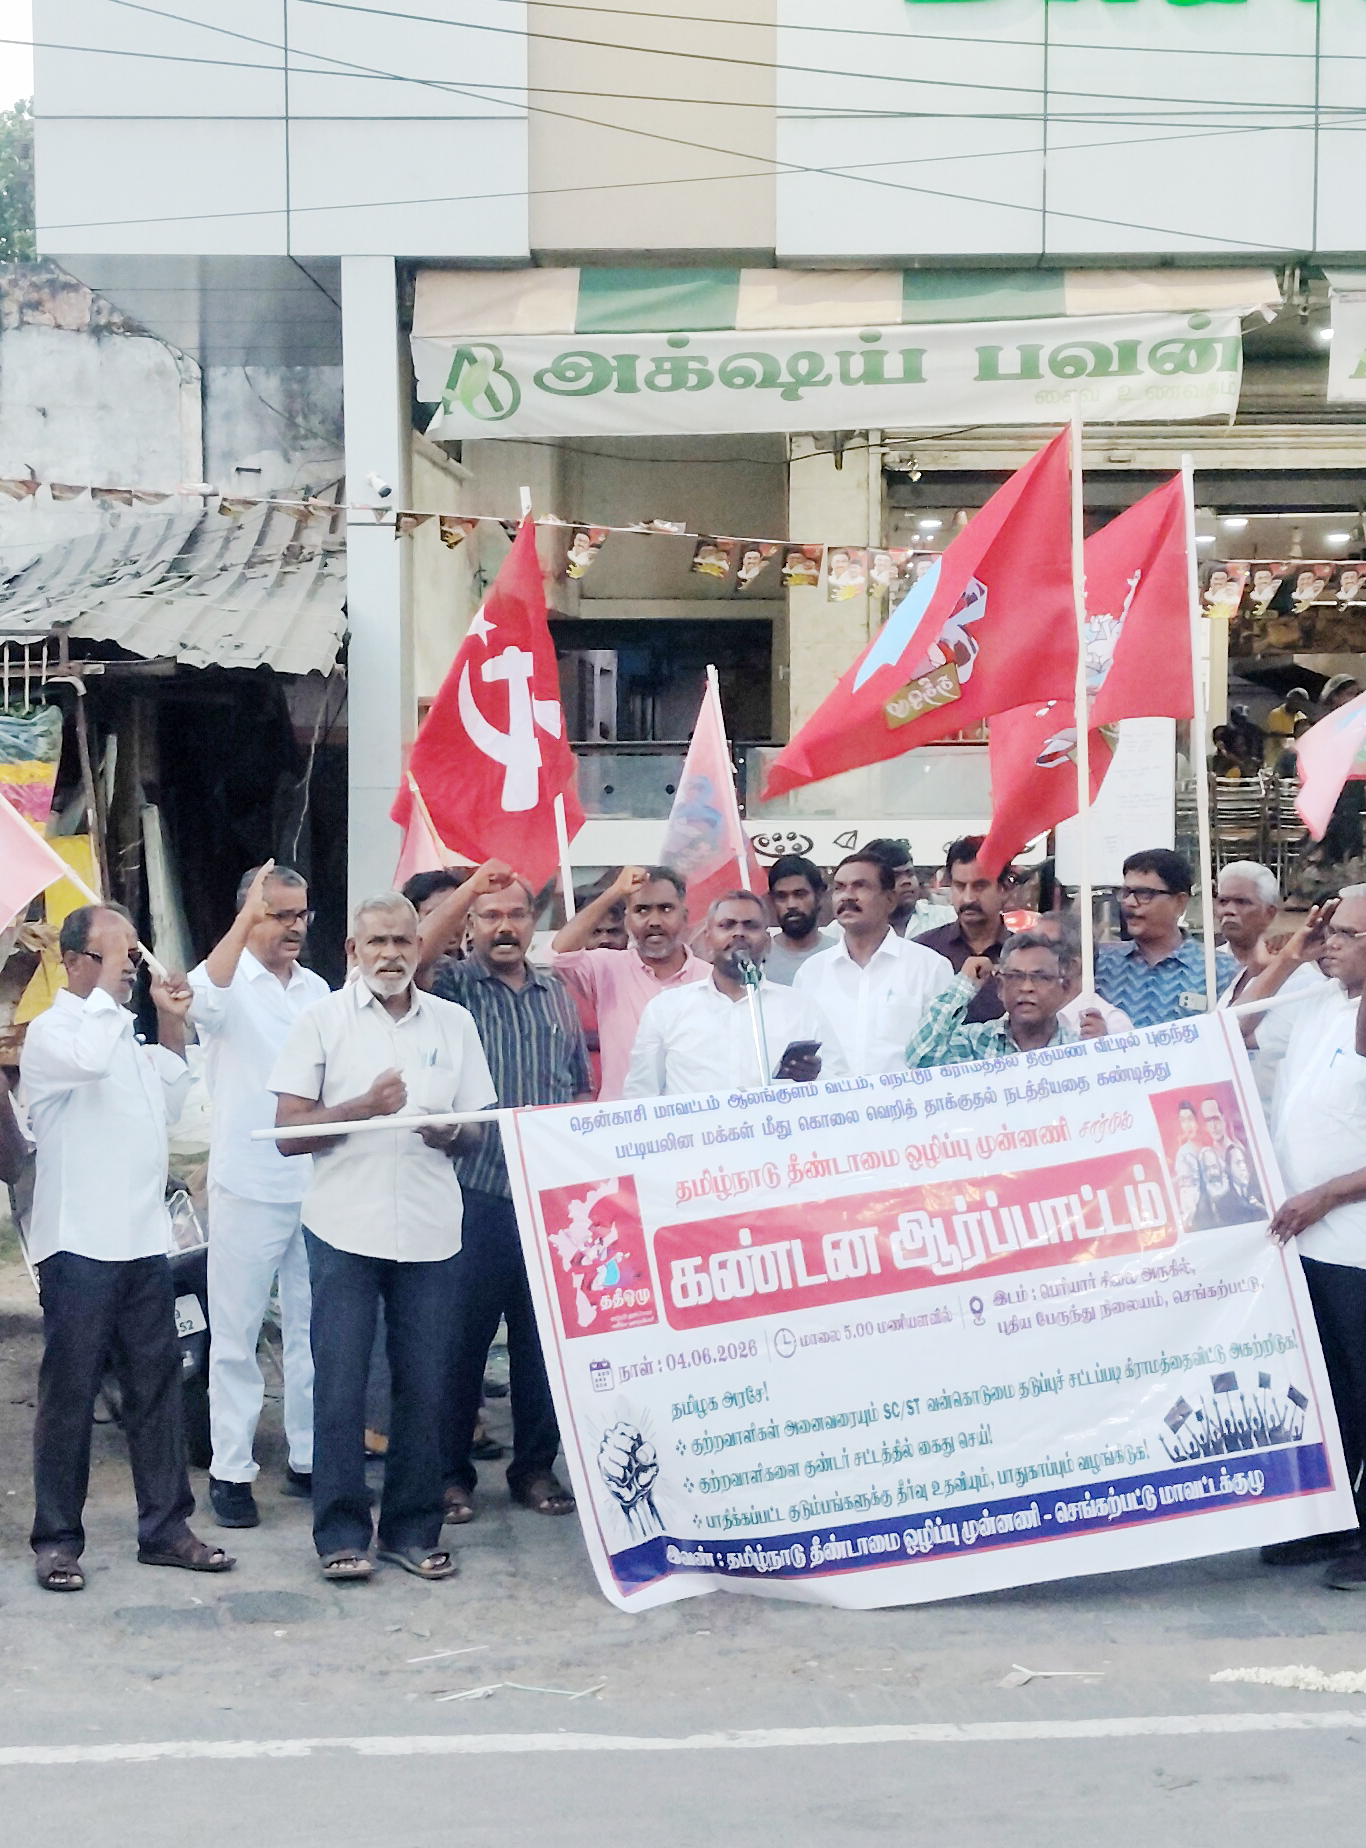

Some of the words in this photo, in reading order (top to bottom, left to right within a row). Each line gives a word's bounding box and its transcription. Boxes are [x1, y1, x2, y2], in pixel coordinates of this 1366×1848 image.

[973, 313, 1242, 382] பவன்
[570, 1104, 647, 1135] தென்காசி
[654, 1095, 720, 1119] மாவட்டம்
[727, 1080, 819, 1110] ஆலங்குளம்
[702, 1122, 755, 1146] மக்கள்
[762, 1115, 792, 1140] மீது
[798, 1110, 860, 1132] கொலை
[924, 1086, 998, 1118] தாக்குதல்
[1005, 1074, 1090, 1105] நடத்தியதை
[1097, 1061, 1172, 1088] கண்டித்து
[675, 1162, 781, 1206] தமிழ்நாடு
[787, 1151, 900, 1185] தீண்டாமை
[904, 1133, 971, 1173] ஒழிப்பு
[975, 1115, 1071, 1159] முன்னணி
[670, 1226, 882, 1309] கண்டன
[889, 1163, 1167, 1276] ஆர்ப்பாட்டம்
[992, 1287, 1029, 1308] இடம்
[1039, 1275, 1097, 1300] பெரியார்
[998, 1312, 1033, 1336] புதிய
[1036, 1301, 1097, 1329] பேருந்து
[618, 1355, 655, 1385] நாள்
[666, 1339, 759, 1371] 04.06.2026
[799, 1326, 841, 1348] மாலை
[844, 1320, 874, 1341] 5.00
[671, 1393, 719, 1422] தமிழக
[691, 1418, 781, 1456] குற்றவாளிகள்
[784, 1401, 879, 1437] அனைவரையும்
[883, 1397, 921, 1423] SC/ST
[925, 1382, 1016, 1413] வன்கொடுமை
[698, 1461, 800, 1495] குற்றவாளிகளை
[804, 1450, 850, 1480] குண்டர்
[918, 1433, 955, 1459] கைது
[726, 1542, 806, 1573] தமிழ்நாடு
[809, 1531, 901, 1569] தீண்டாமை
[903, 1516, 960, 1555] ஒழிப்பு
[961, 1501, 1042, 1547] முன்னணி
[1055, 1485, 1159, 1524] செங்கற்பட்டு
[1160, 1466, 1265, 1504] மாவட்டக்குழு
